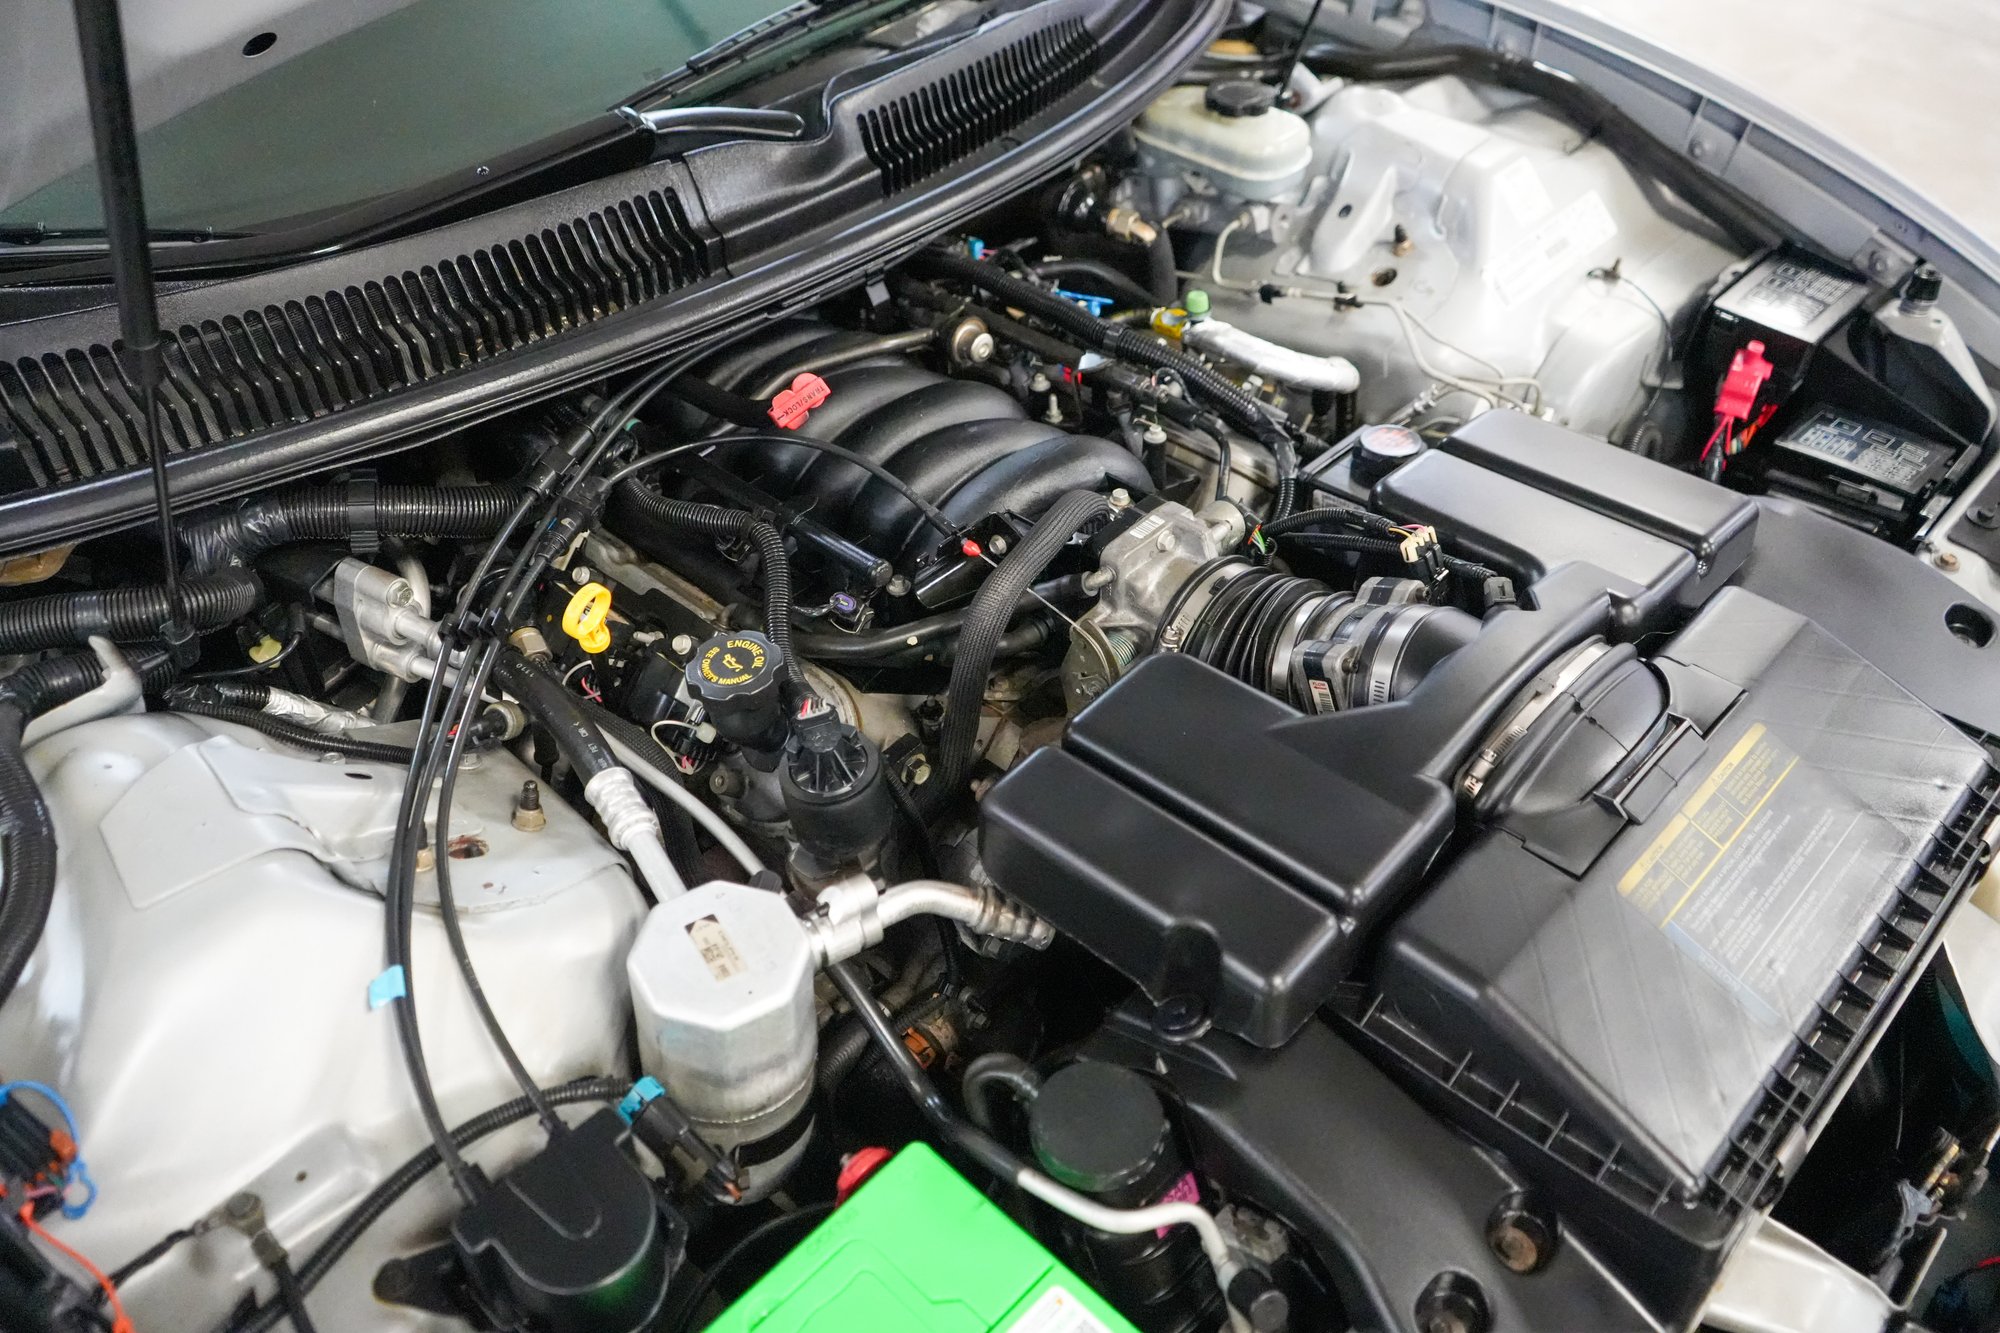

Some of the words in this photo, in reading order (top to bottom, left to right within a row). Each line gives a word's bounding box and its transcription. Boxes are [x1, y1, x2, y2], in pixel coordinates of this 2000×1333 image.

[782, 385, 825, 417] TRANS/LOCK
[706, 646, 720, 659] SEE
[726, 639, 764, 657] ENGINE
[751, 656, 765, 670] OIL
[701, 659, 719, 683] OWNER'S
[717, 673, 753, 685] MANUAL
